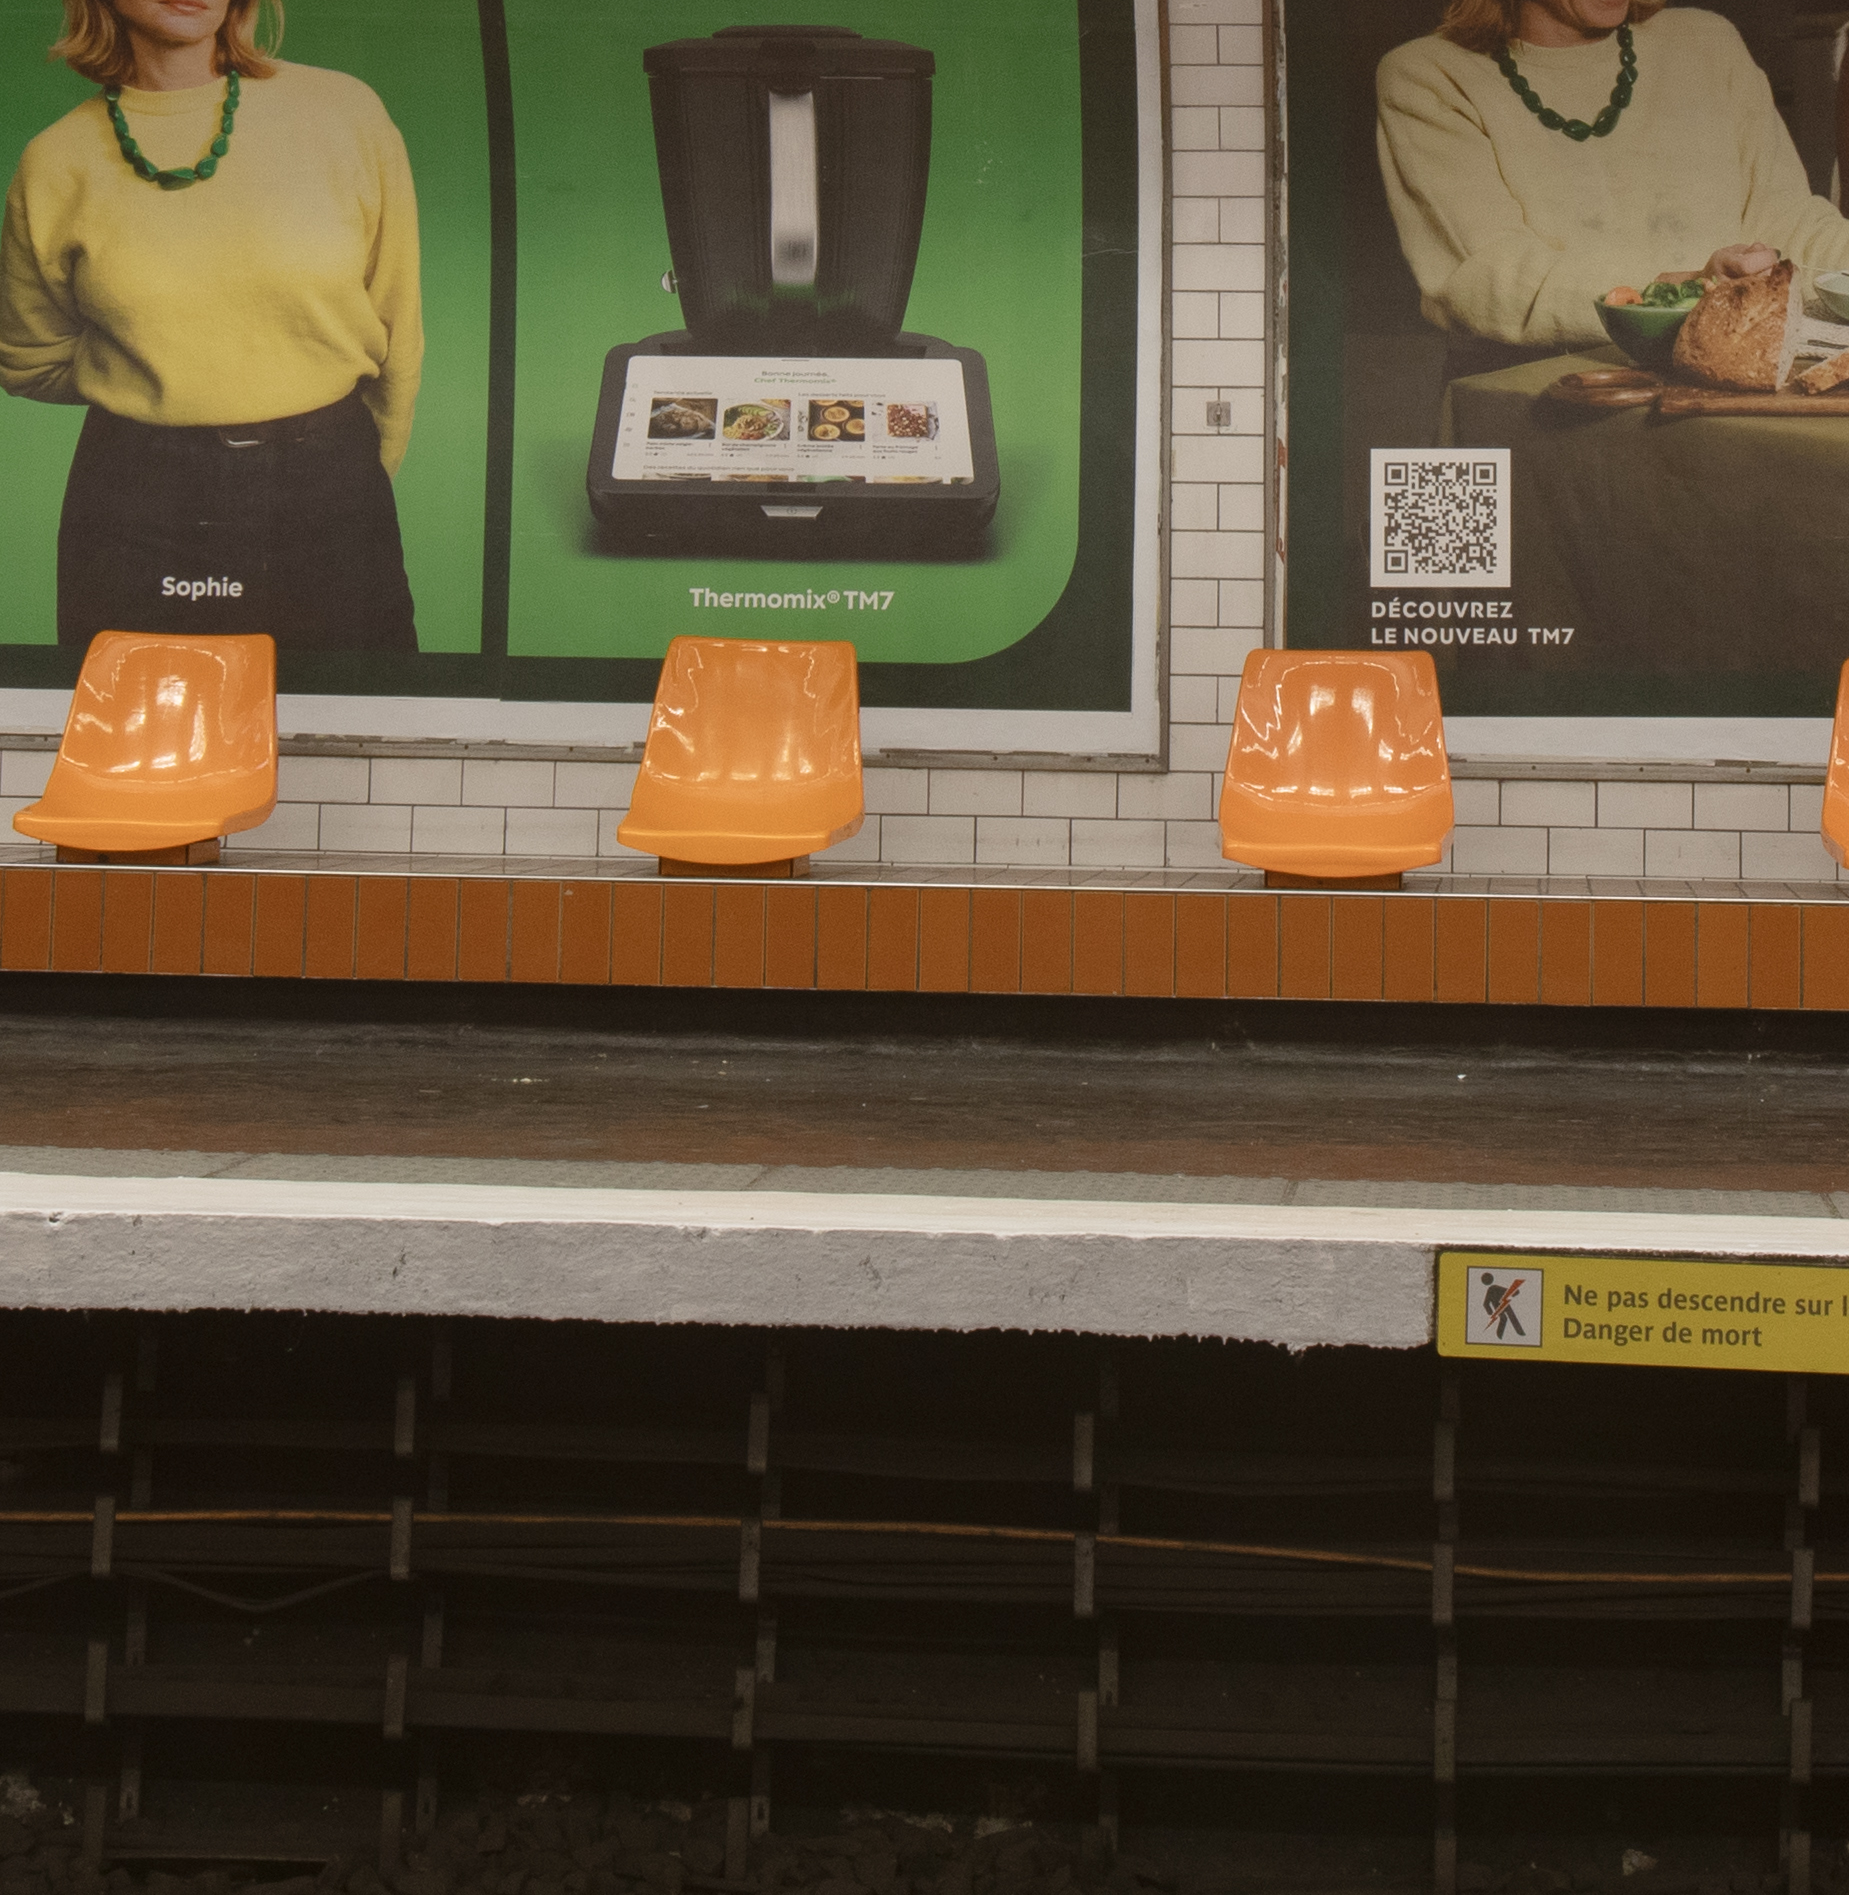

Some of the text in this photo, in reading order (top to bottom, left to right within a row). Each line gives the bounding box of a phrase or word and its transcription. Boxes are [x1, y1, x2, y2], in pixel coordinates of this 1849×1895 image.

[161, 576, 244, 602] Sophie
[689, 588, 895, 611] Thermomix® TM7
[1371, 597, 1513, 619] DÉCOUVREZ
[1371, 627, 1574, 645] LE NOUVEAU TM7
[1563, 1284, 1598, 1306] Ne
[1607, 1290, 1649, 1312] pas
[1657, 1288, 1786, 1315] descendre
[1795, 1298, 1834, 1316] sur
[1563, 1317, 1763, 1347] Danger de mort
